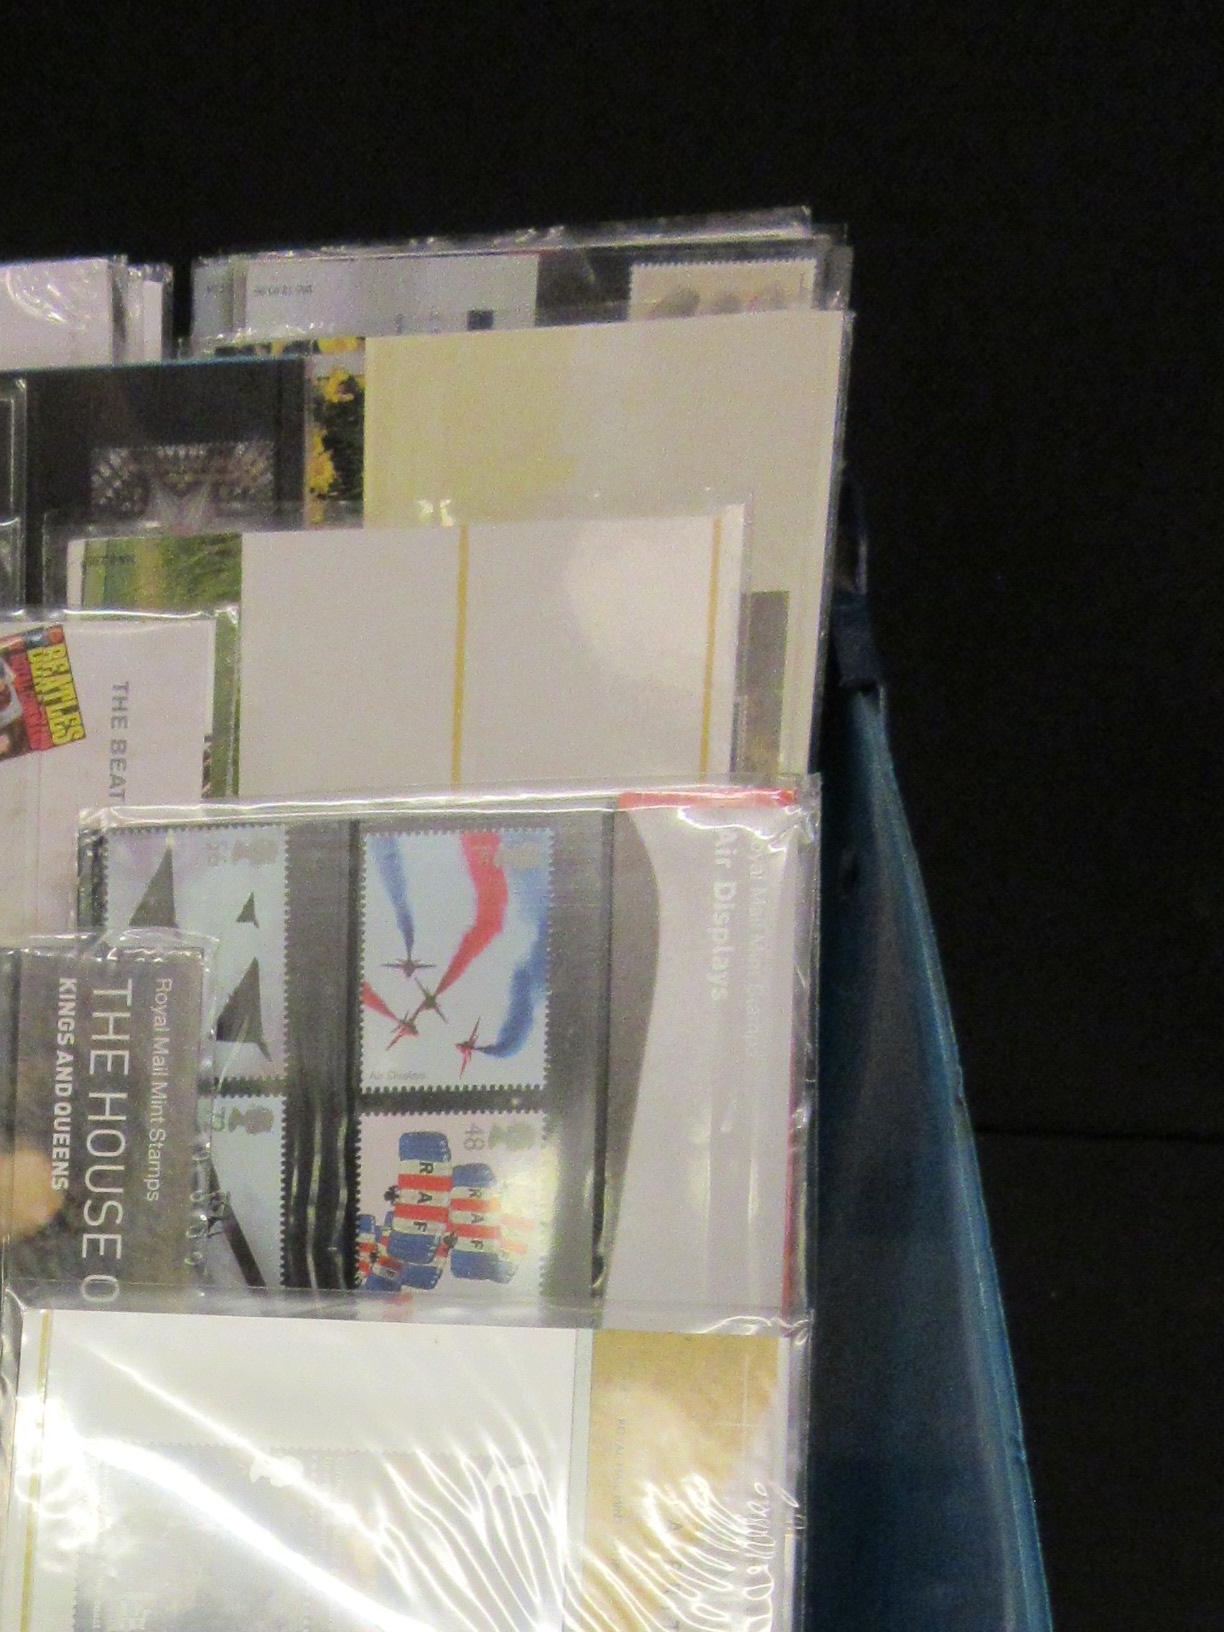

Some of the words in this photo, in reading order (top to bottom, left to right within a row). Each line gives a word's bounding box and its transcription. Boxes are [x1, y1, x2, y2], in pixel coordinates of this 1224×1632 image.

[111, 680, 130, 730] THE
[109, 738, 129, 802] BEAT
[714, 829, 740, 869] Air
[706, 879, 739, 1002] Displays
[56, 976, 78, 1046] KINGS
[88, 977, 134, 1076] THE
[149, 977, 173, 1030] Royal
[54, 1049, 75, 1097] AND
[151, 1037, 170, 1077] Mail
[149, 1082, 168, 1124] Mint
[51, 1101, 73, 1192] QUEENS
[143, 1127, 165, 1202] Stamps
[463, 1124, 486, 1152] 48
[80, 1091, 130, 1260] HOUSE
